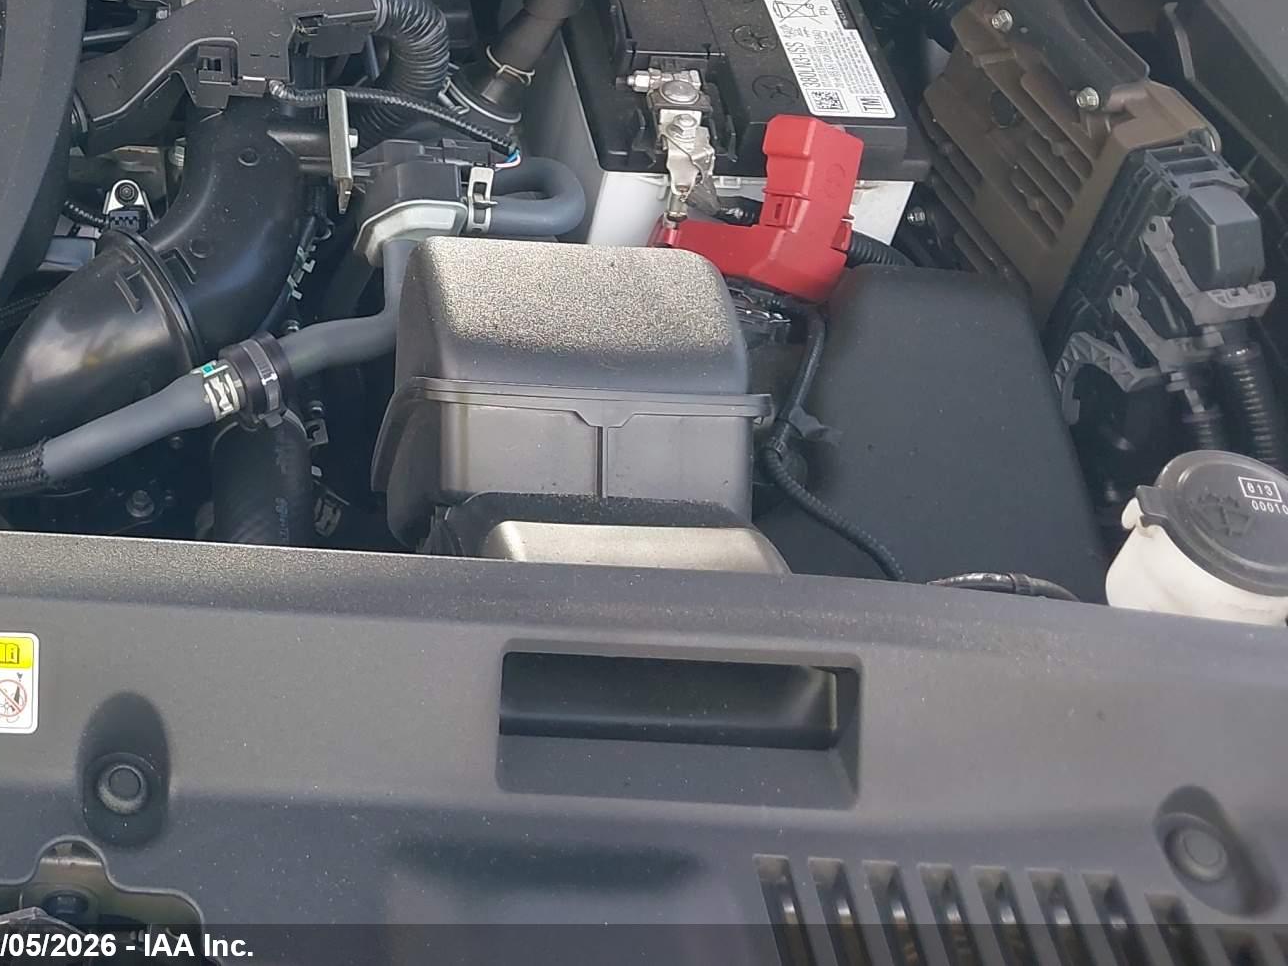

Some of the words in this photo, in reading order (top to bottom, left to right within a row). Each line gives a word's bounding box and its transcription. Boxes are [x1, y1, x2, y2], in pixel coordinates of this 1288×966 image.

[819, 5, 828, 15] Pb
[785, 42, 821, 88] 380LN3-ISS
[860, 97, 883, 112] TM
